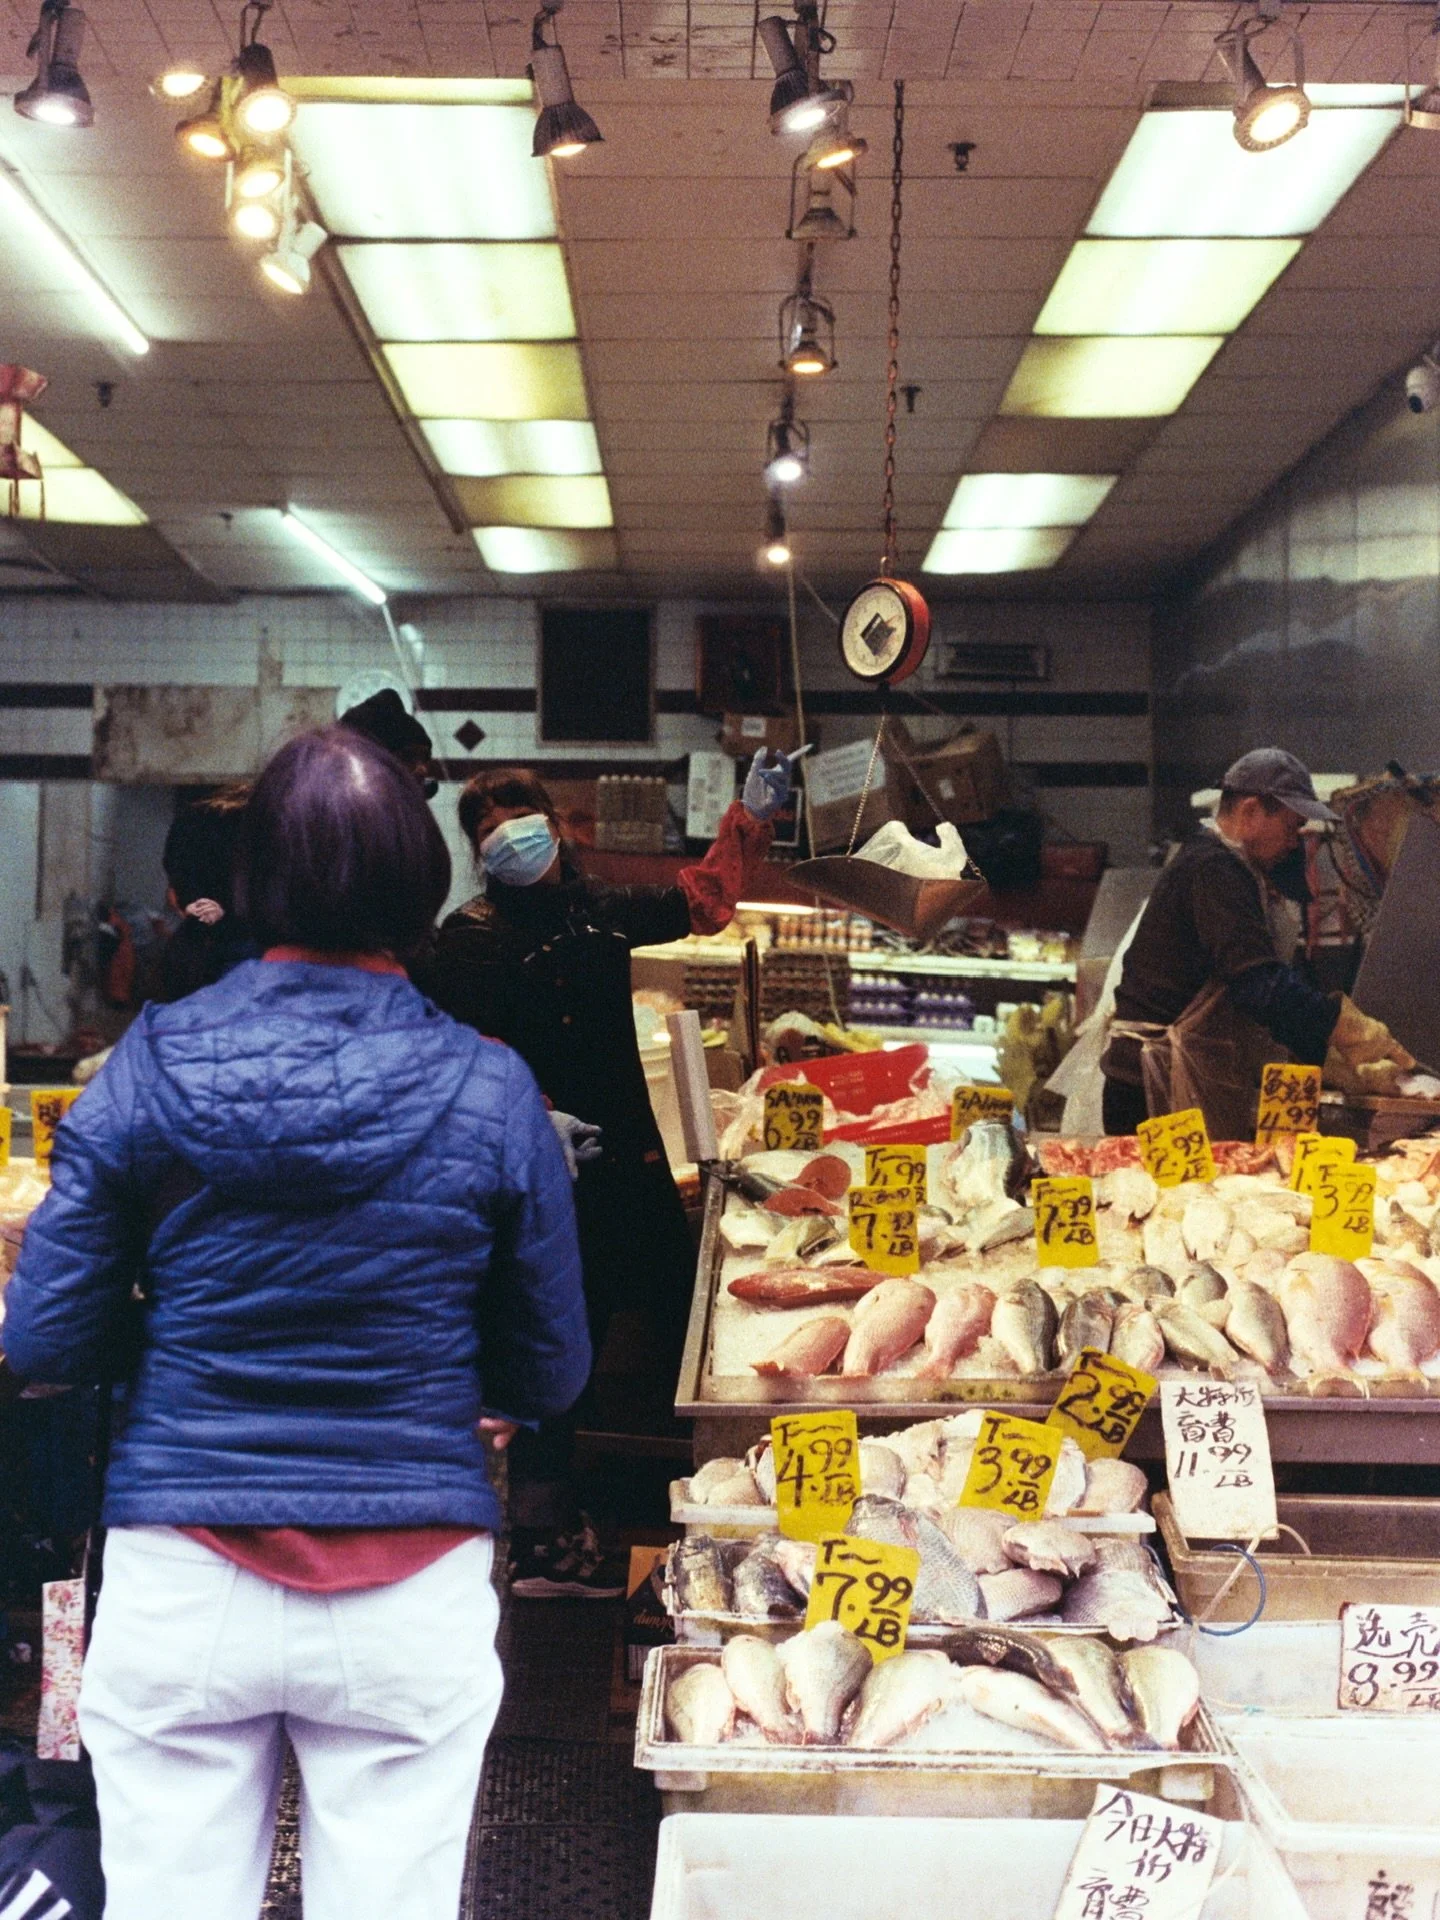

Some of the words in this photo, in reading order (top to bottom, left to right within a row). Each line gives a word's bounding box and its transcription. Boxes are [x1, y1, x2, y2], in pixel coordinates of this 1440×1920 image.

[1056, 1370, 1147, 1427] 2.99
[776, 1438, 853, 1508] 4.99
[818, 1479, 858, 1506] LB
[975, 1446, 1053, 1494] 3.99
[1174, 1443, 1252, 1479] 11.99
[1214, 1474, 1253, 1489] LB
[1001, 1488, 1040, 1511] LB
[816, 1571, 914, 1621] 7.99
[853, 1617, 902, 1648] LB
[1347, 1660, 1440, 1707] 8.99
